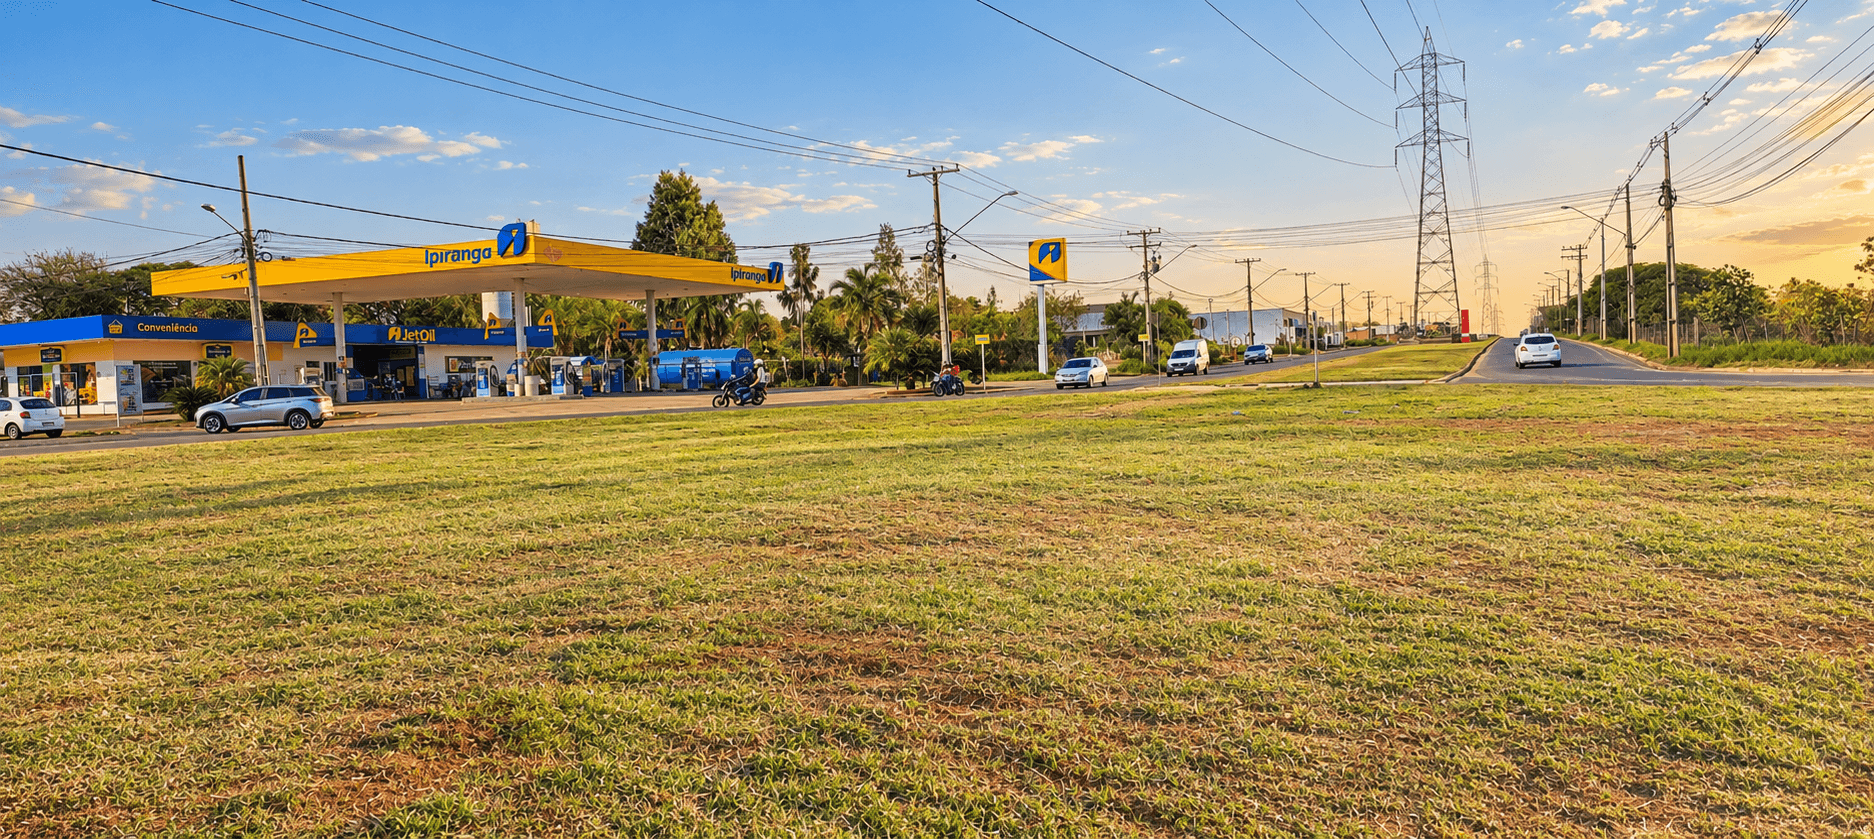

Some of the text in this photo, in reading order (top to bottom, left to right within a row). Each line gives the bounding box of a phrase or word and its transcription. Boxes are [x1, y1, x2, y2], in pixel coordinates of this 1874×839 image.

[425, 247, 492, 268] Ipiranga
[731, 266, 766, 284] Ipiranga
[137, 322, 198, 333] Conveniência
